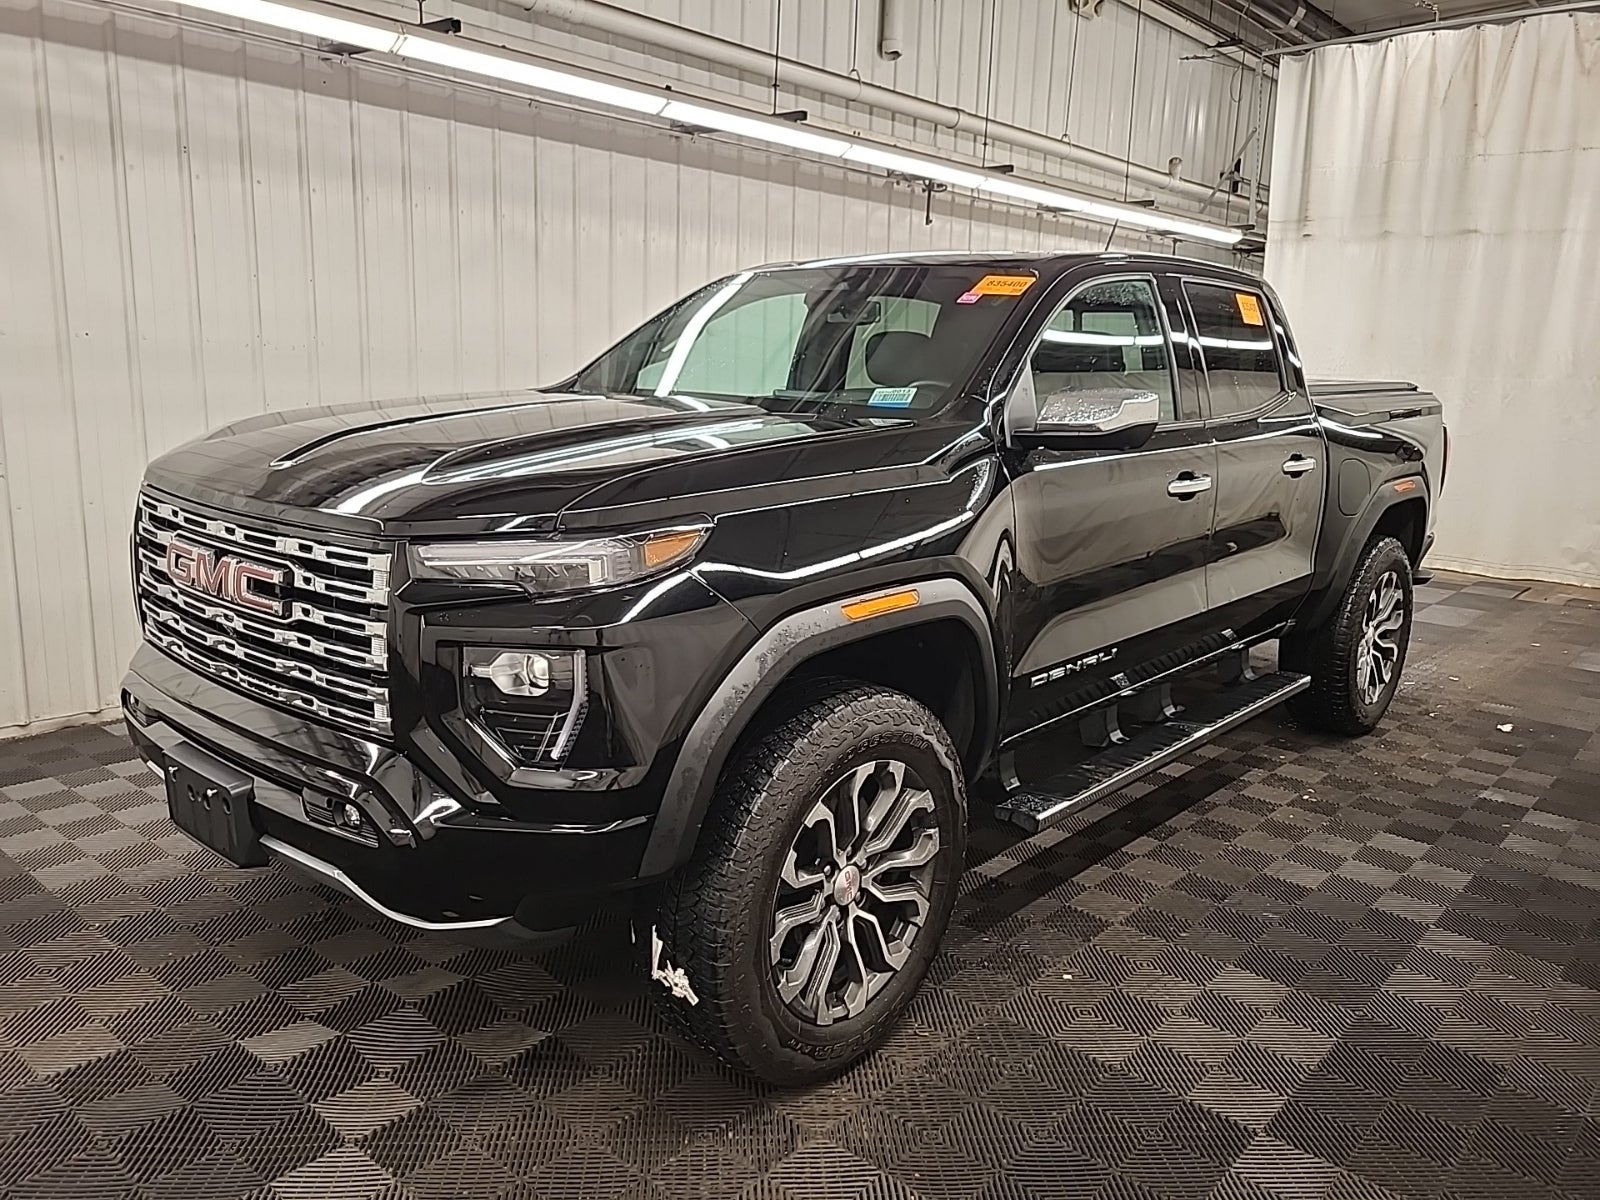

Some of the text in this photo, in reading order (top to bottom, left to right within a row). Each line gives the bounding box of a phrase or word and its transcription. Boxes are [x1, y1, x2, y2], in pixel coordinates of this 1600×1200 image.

[167, 541, 283, 616] GMC
[1030, 648, 1118, 689] DENALI
[844, 870, 853, 901] GMC
